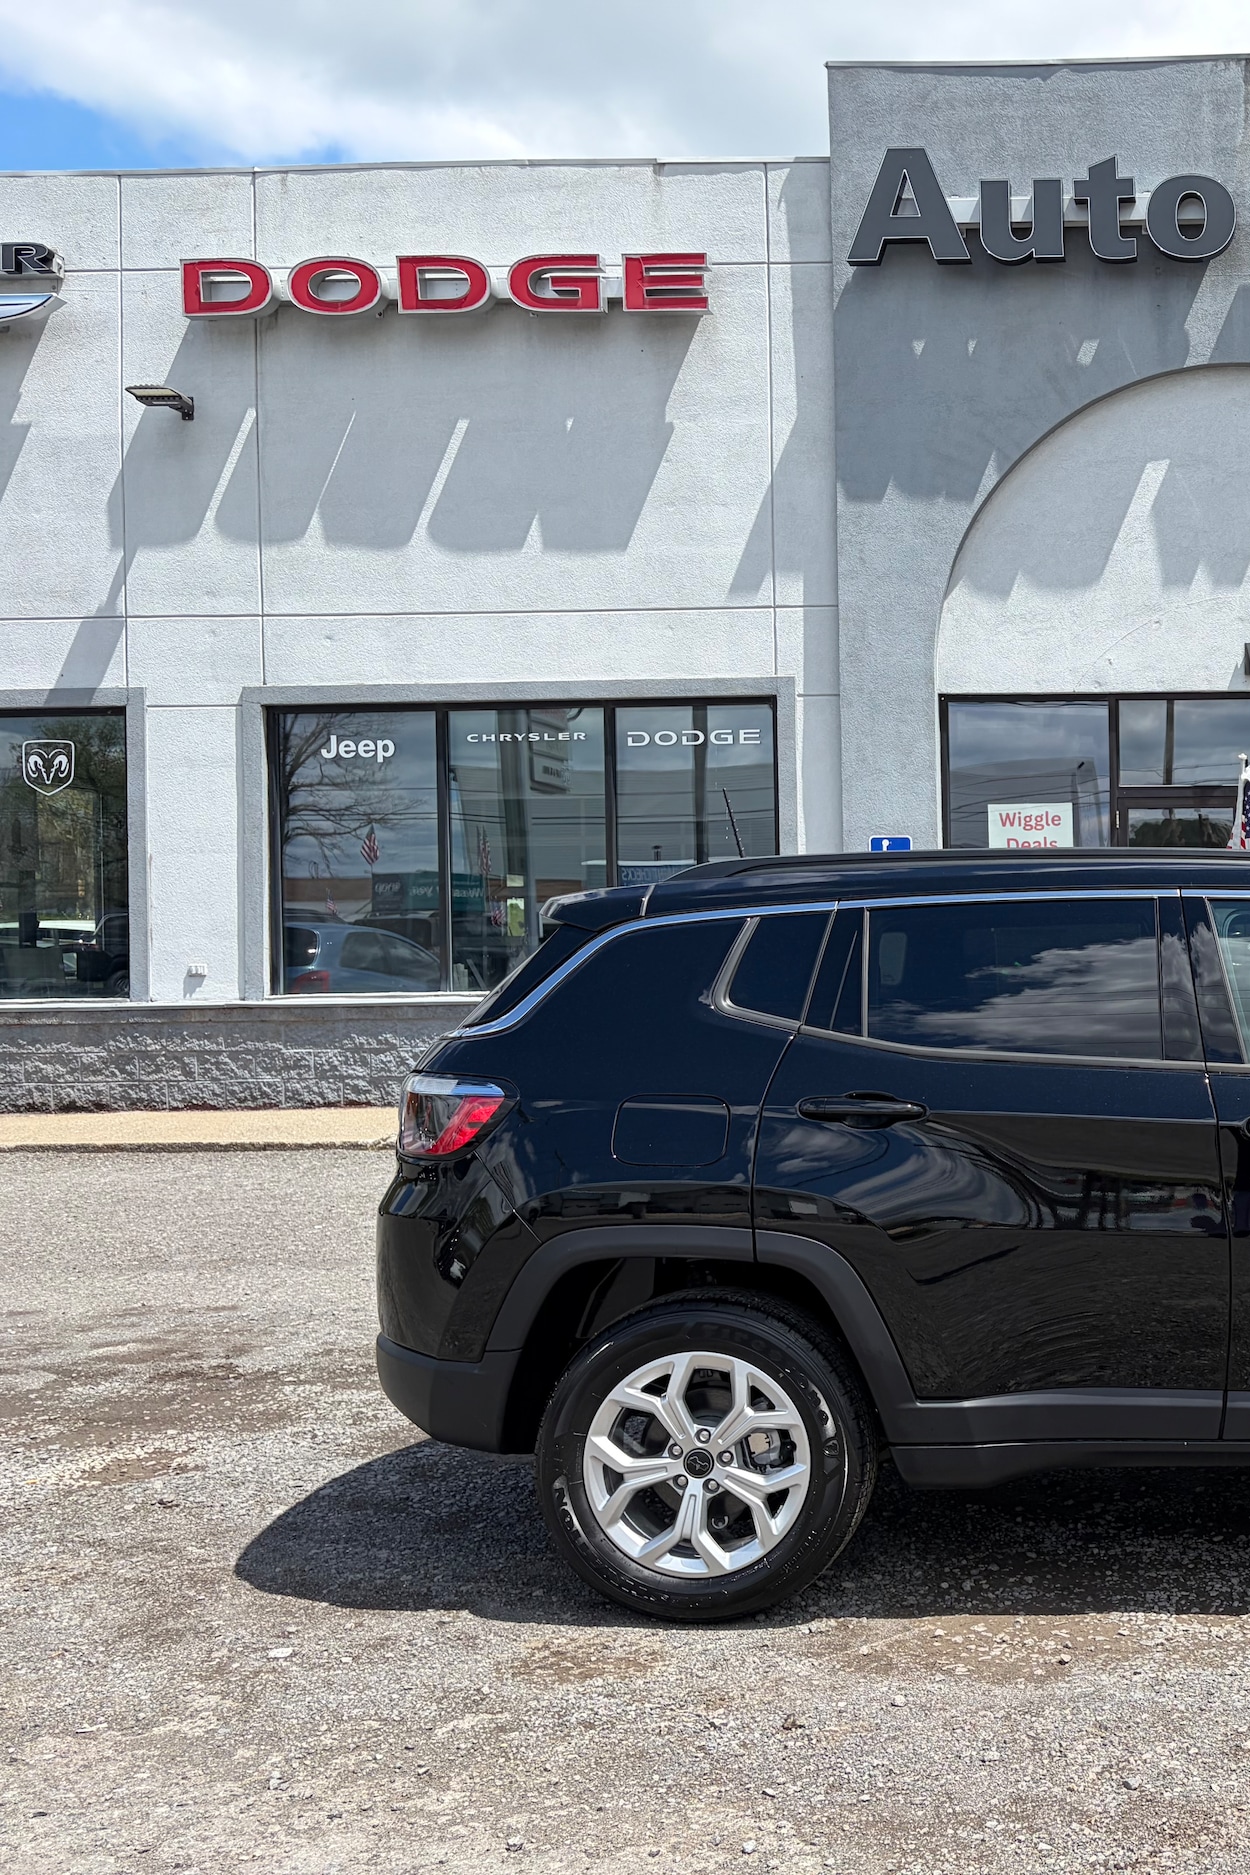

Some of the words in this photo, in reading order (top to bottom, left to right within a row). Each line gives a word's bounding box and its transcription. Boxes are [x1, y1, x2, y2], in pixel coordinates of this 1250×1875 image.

[847, 146, 1236, 266] Auto
[180, 253, 711, 317] DODGE
[466, 731, 588, 743] CHRYSLER
[627, 729, 762, 747] DODGE
[321, 735, 396, 763] Jeep
[999, 811, 1062, 831] Wiggle
[1006, 836, 1058, 848] Deals
